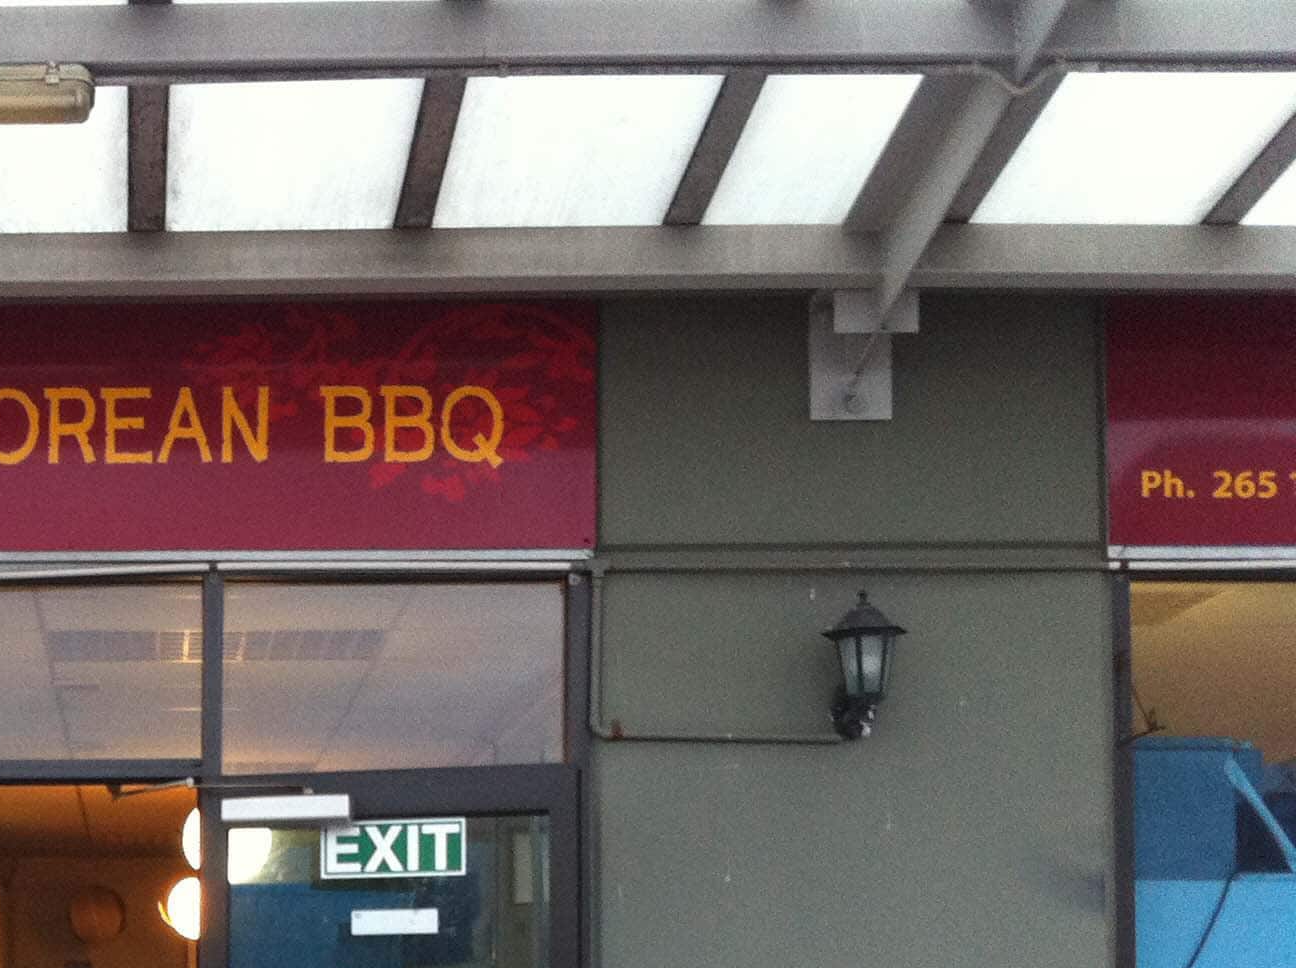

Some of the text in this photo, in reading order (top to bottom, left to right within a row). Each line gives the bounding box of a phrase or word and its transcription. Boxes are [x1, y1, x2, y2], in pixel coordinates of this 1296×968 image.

[319, 385, 506, 470] BBQ
[1140, 470, 1196, 498] Ph.
[1212, 470, 1278, 499] 265
[326, 824, 462, 875] EXIT
